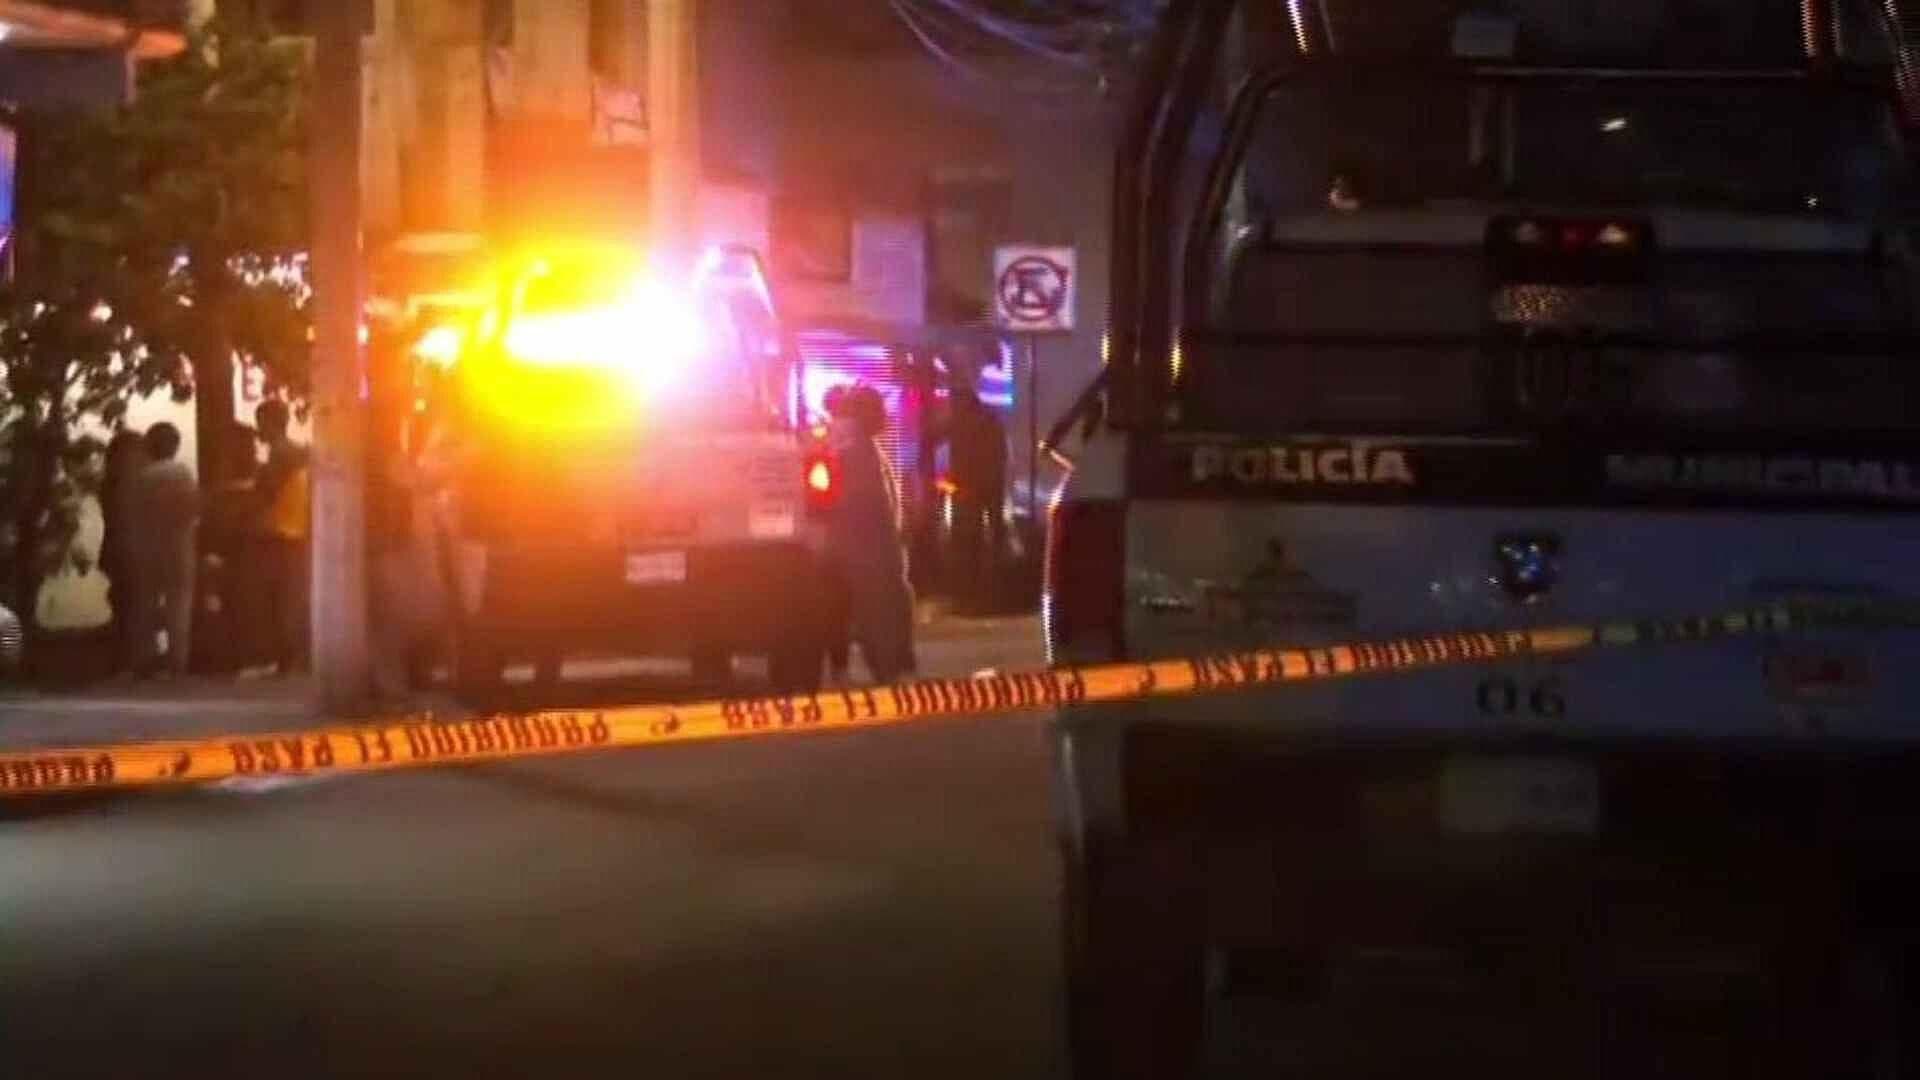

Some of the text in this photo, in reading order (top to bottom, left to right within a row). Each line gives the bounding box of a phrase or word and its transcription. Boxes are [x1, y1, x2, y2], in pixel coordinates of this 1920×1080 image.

[1191, 441, 1415, 485] POLICÍA
[1475, 674, 1566, 718] 06
[230, 736, 335, 775] PASO
[407, 714, 610, 761] PROHIBIDO
